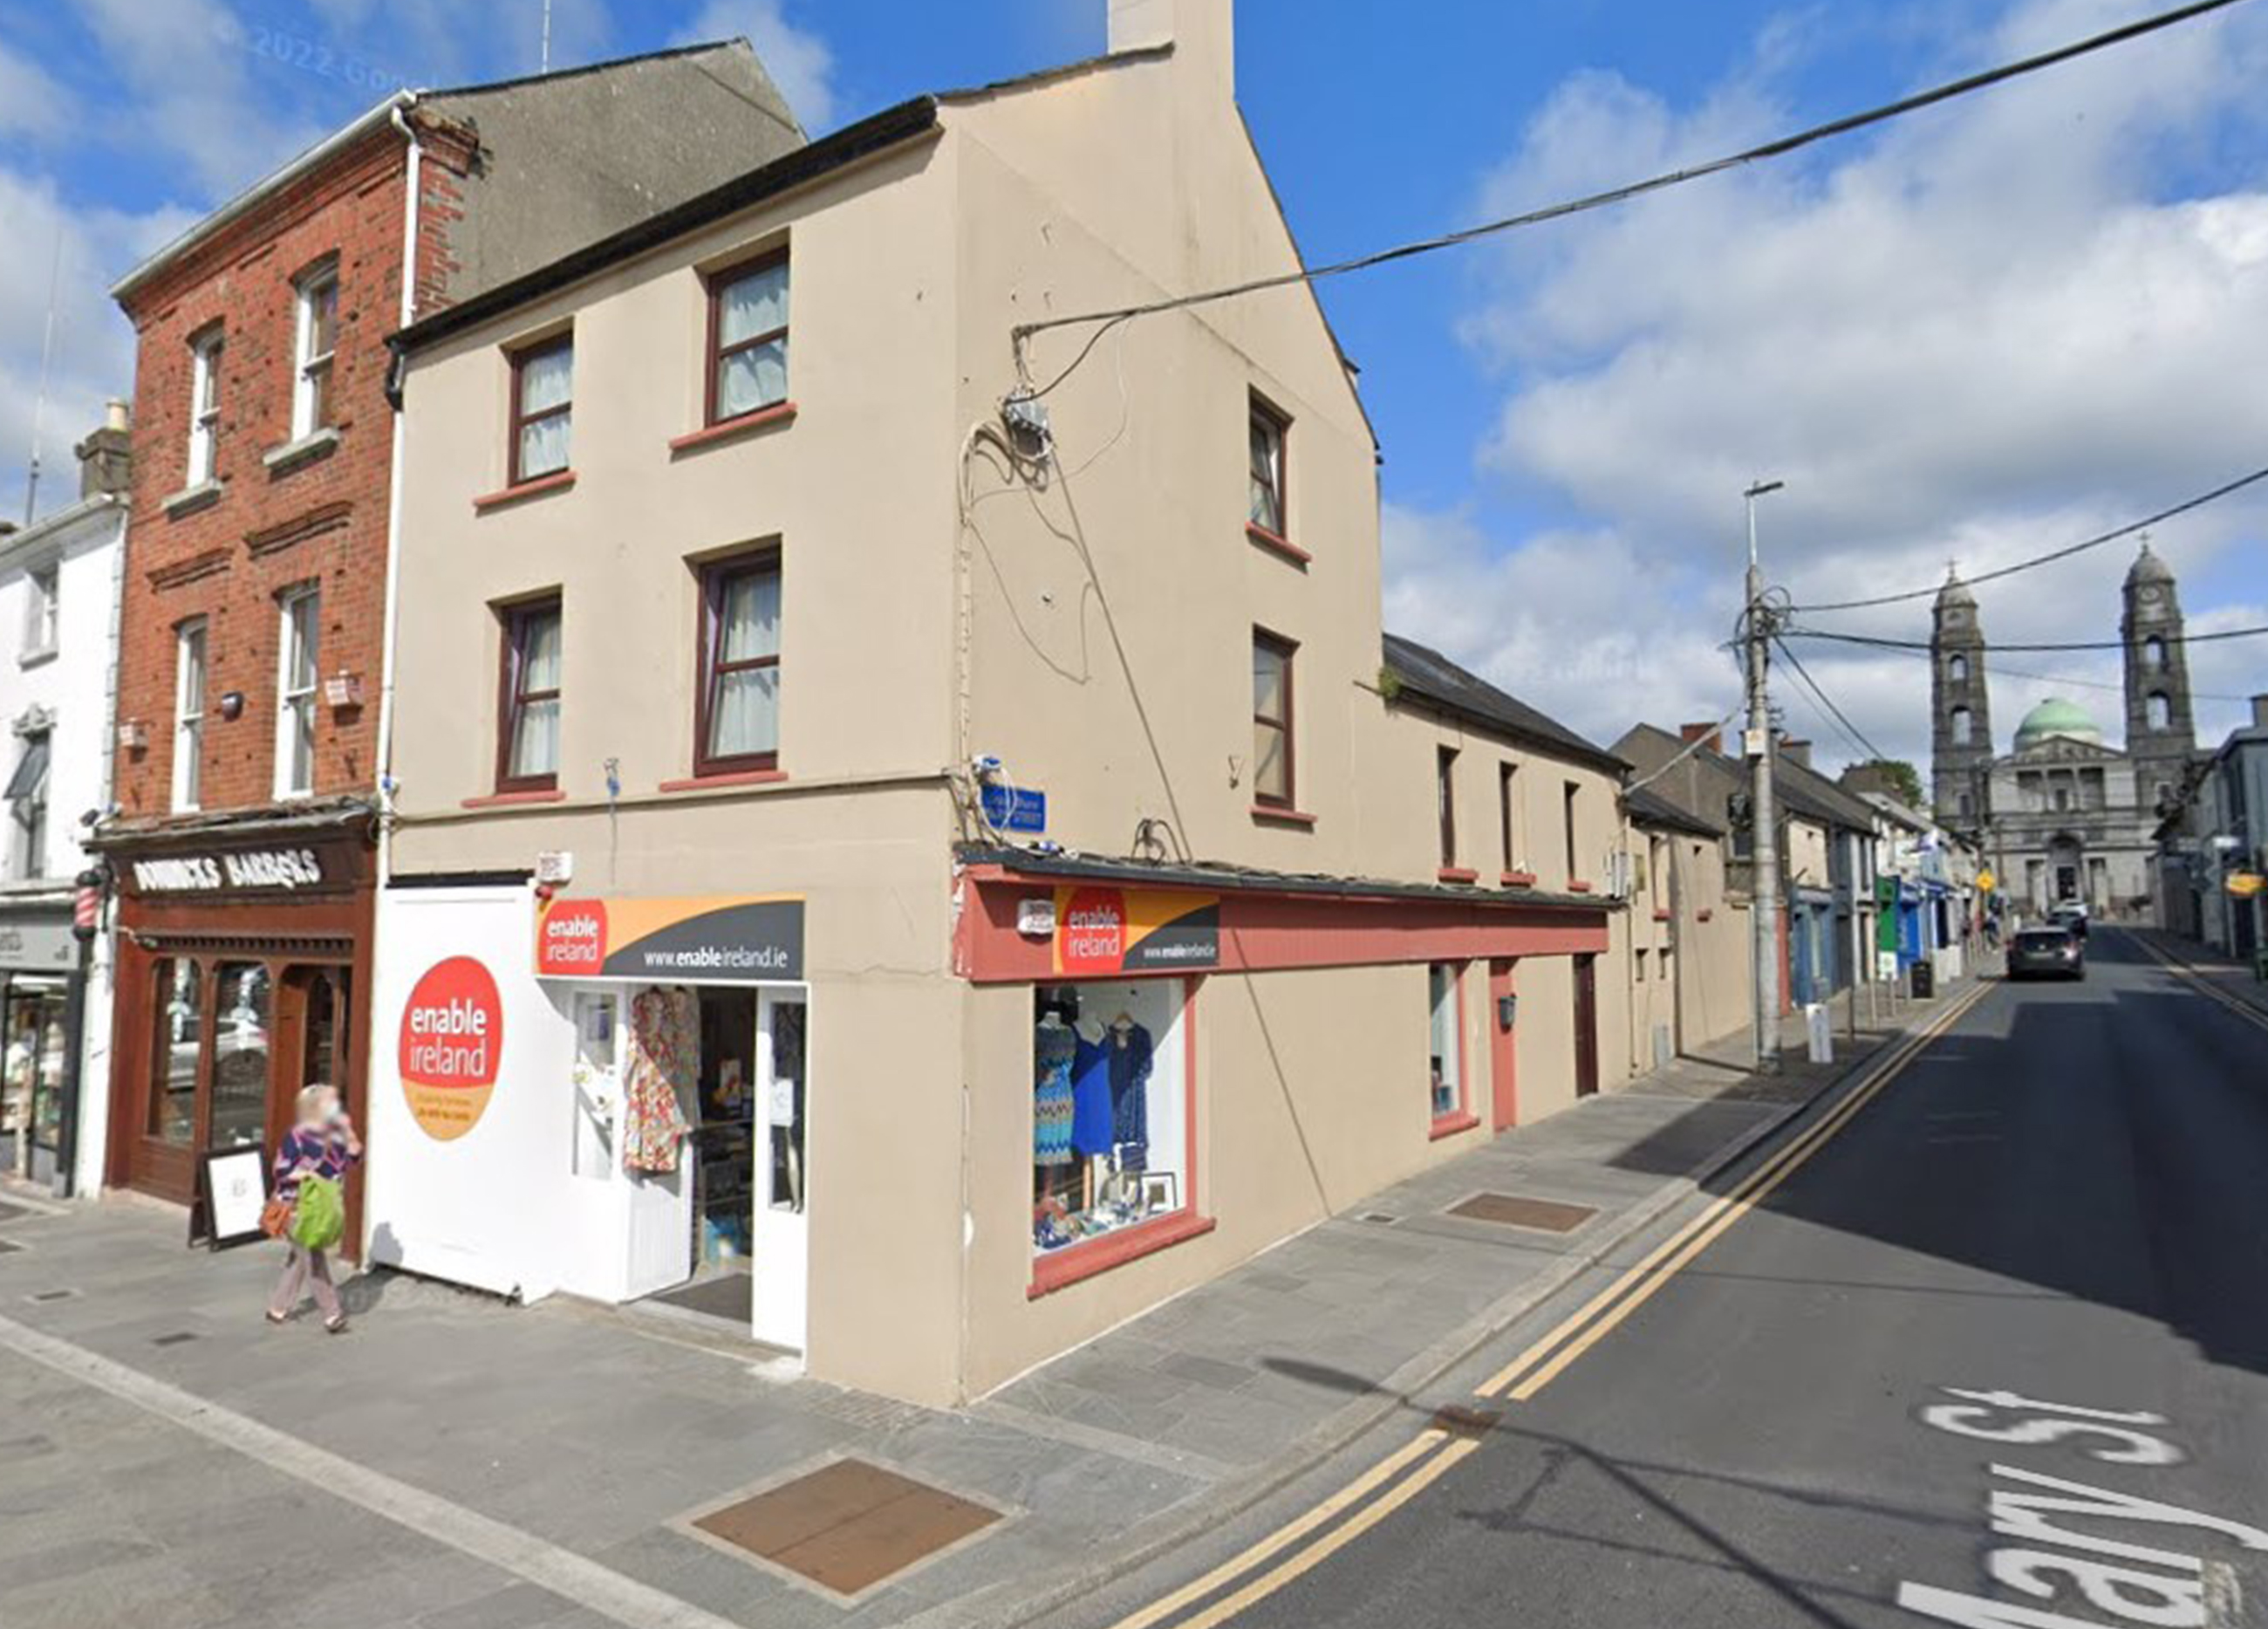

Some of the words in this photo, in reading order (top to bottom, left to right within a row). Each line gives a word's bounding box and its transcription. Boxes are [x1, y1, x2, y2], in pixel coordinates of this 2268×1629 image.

[547, 914, 598, 937] enable
[1069, 905, 1120, 929] enable
[547, 938, 598, 962] ireland
[644, 946, 788, 968] www.enableireland.ie
[1069, 930, 1120, 958] ireland
[411, 996, 487, 1036] enable
[410, 1037, 486, 1077] ireland
[1923, 1386, 2188, 1466] St
